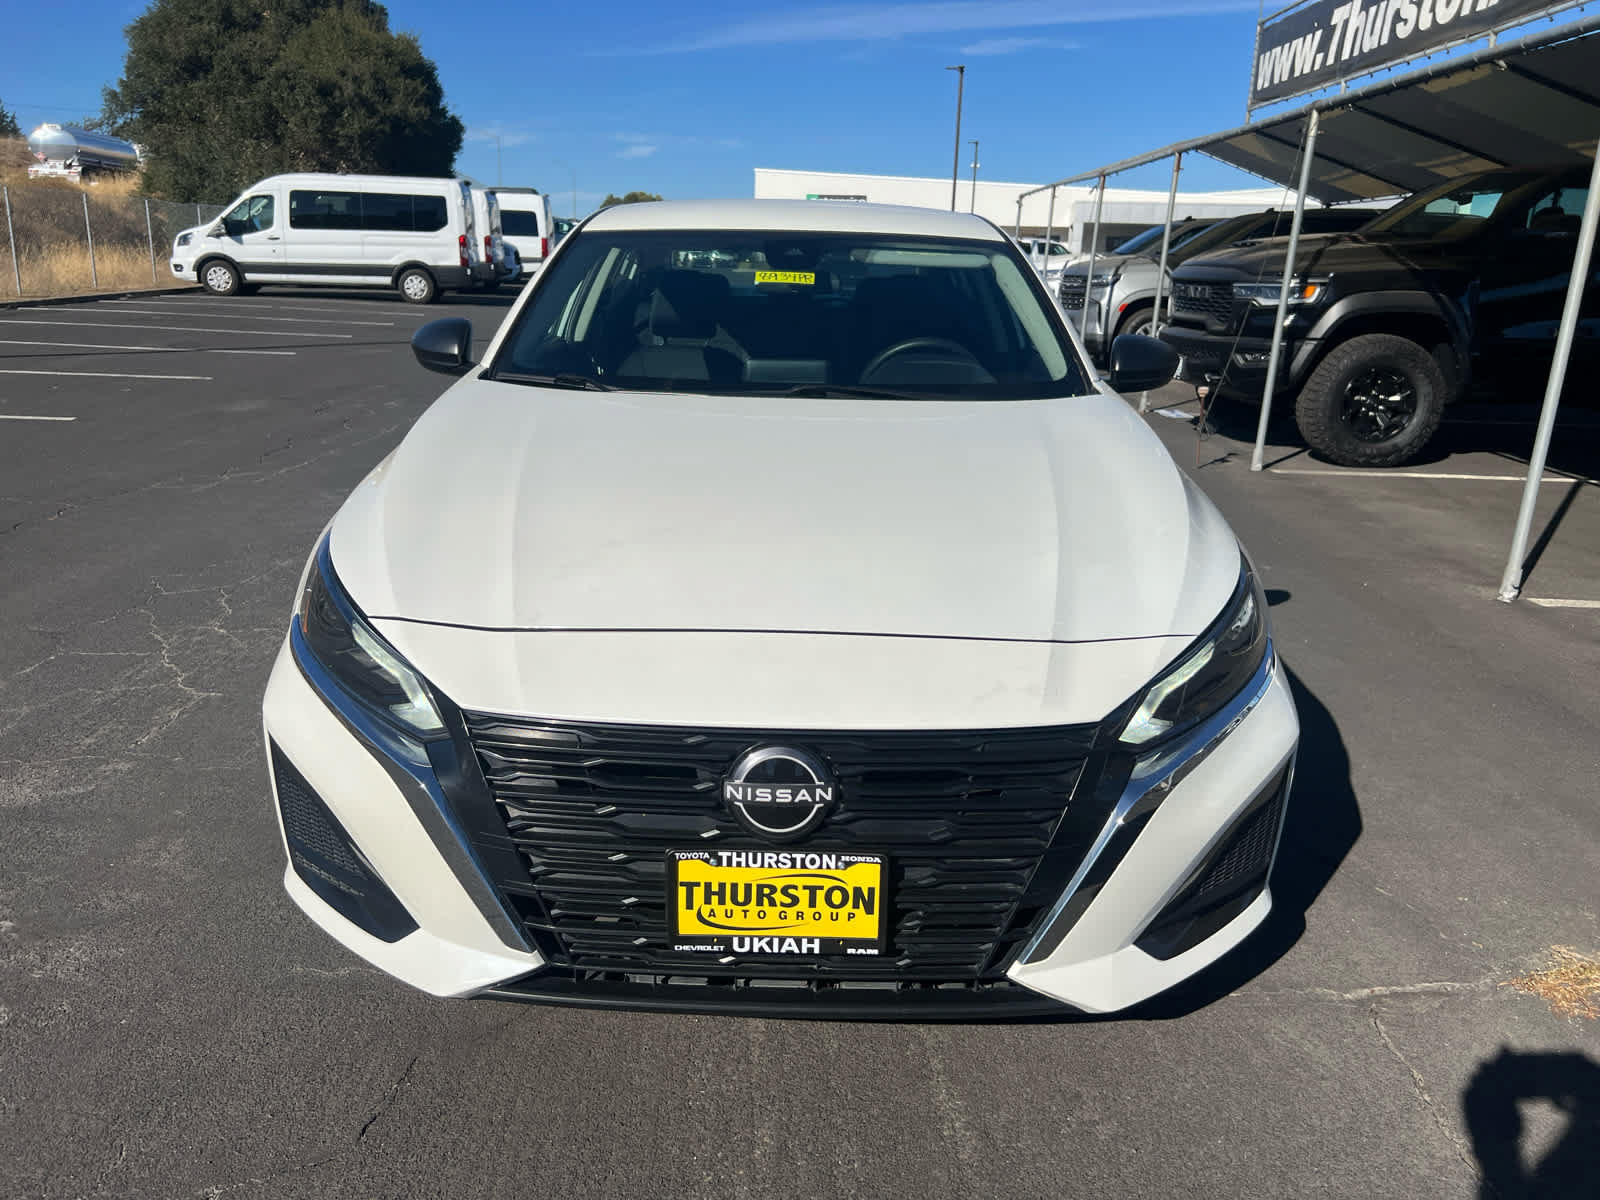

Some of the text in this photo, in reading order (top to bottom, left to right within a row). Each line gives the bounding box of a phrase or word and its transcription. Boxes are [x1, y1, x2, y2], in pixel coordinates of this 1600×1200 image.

[726, 785, 832, 803] NISSAN
[674, 852, 710, 860] TOYOTA
[718, 851, 836, 869] THURSTON
[841, 855, 882, 863] HONDA
[679, 881, 875, 915] THURSTON
[707, 908, 856, 922] AUTO GROUP
[732, 936, 820, 954] UKIAH
